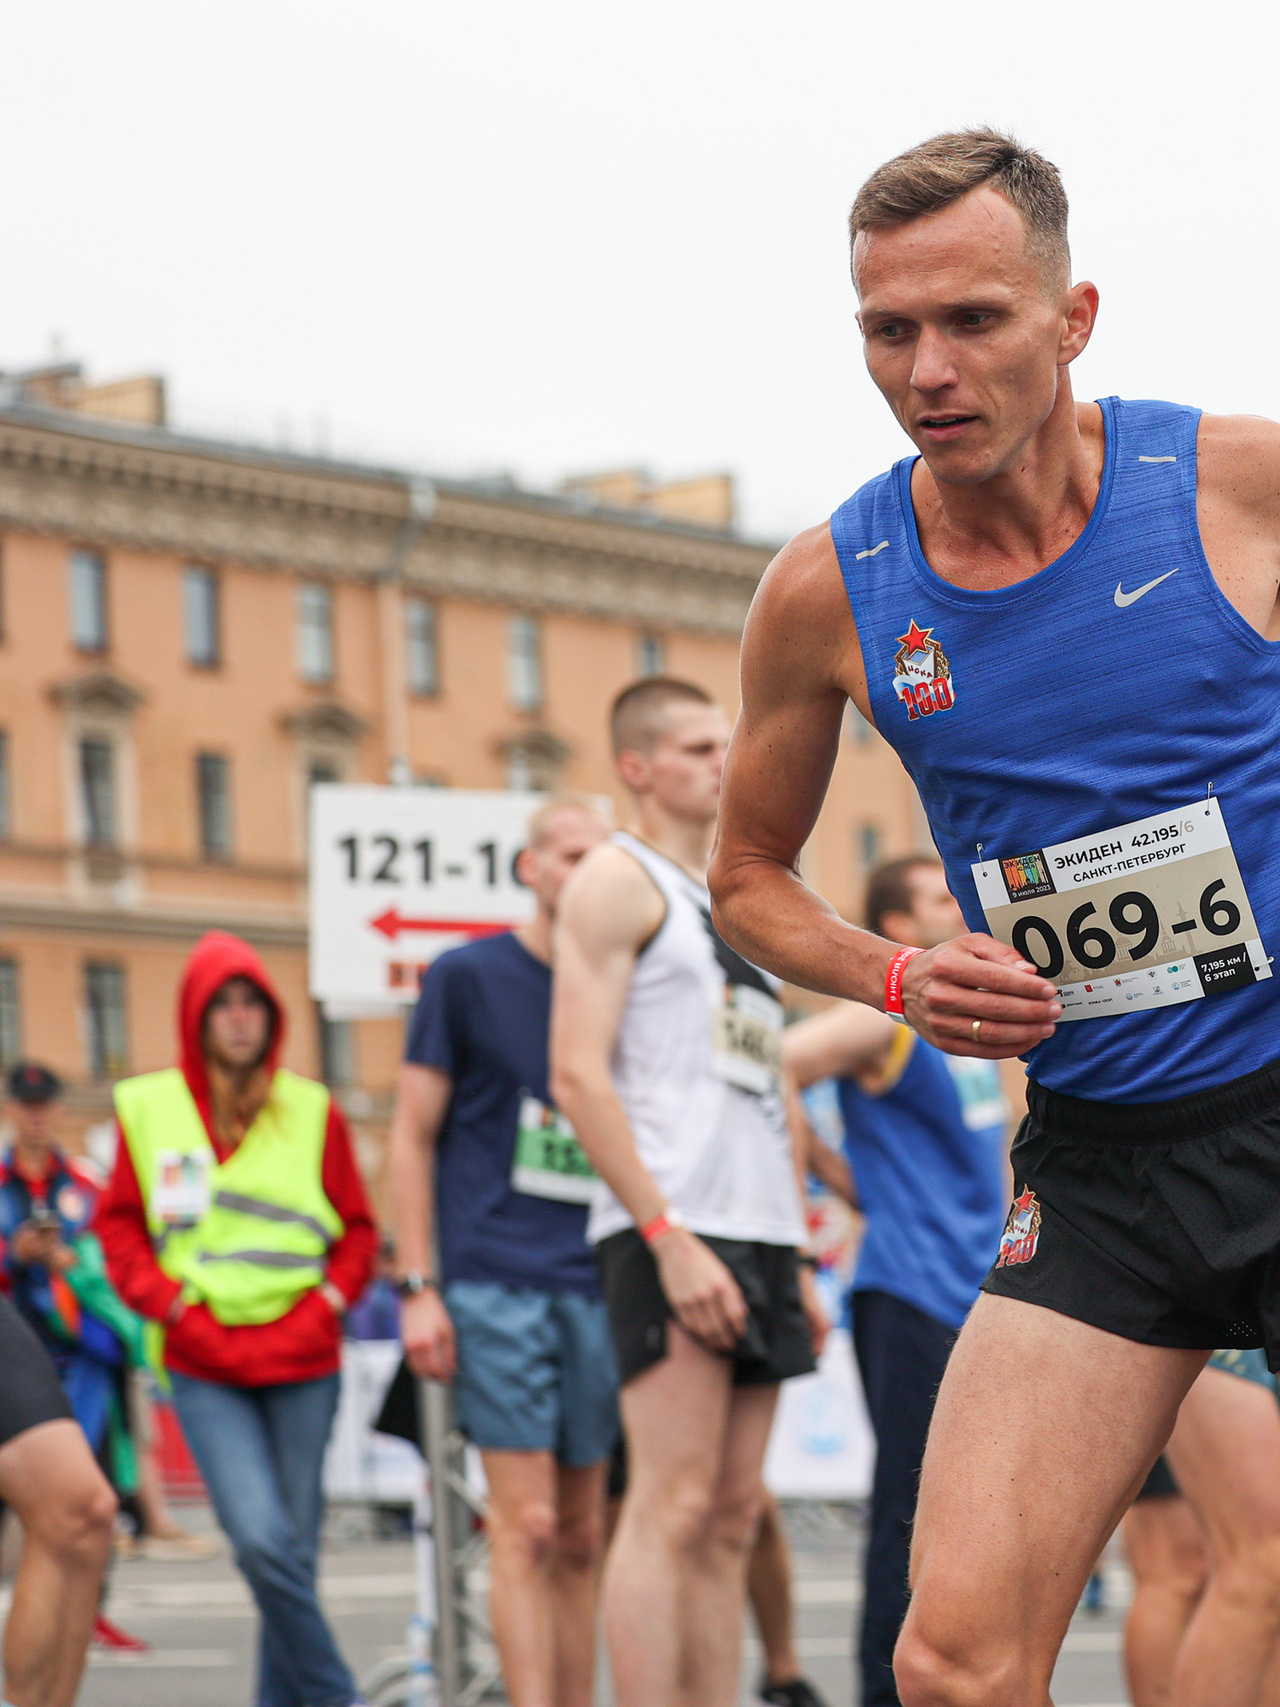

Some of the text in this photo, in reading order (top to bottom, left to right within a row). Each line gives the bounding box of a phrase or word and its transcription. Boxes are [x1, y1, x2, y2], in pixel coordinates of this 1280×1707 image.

[907, 665, 932, 678] ЦСКА
[902, 677, 953, 721] 100
[1054, 820, 1195, 869] ЭКИДЕН 42.195/6
[1073, 843, 1187, 883] САНКТ-ПЕТЕРБУРГ
[1011, 878, 1241, 979] 069-6
[890, 963, 902, 993] ИЮЛЯ
[1201, 962, 1223, 974] 7,195
[1226, 957, 1242, 967] км
[1204, 970, 1236, 982] 6 этап
[996, 1234, 1035, 1267] 100
